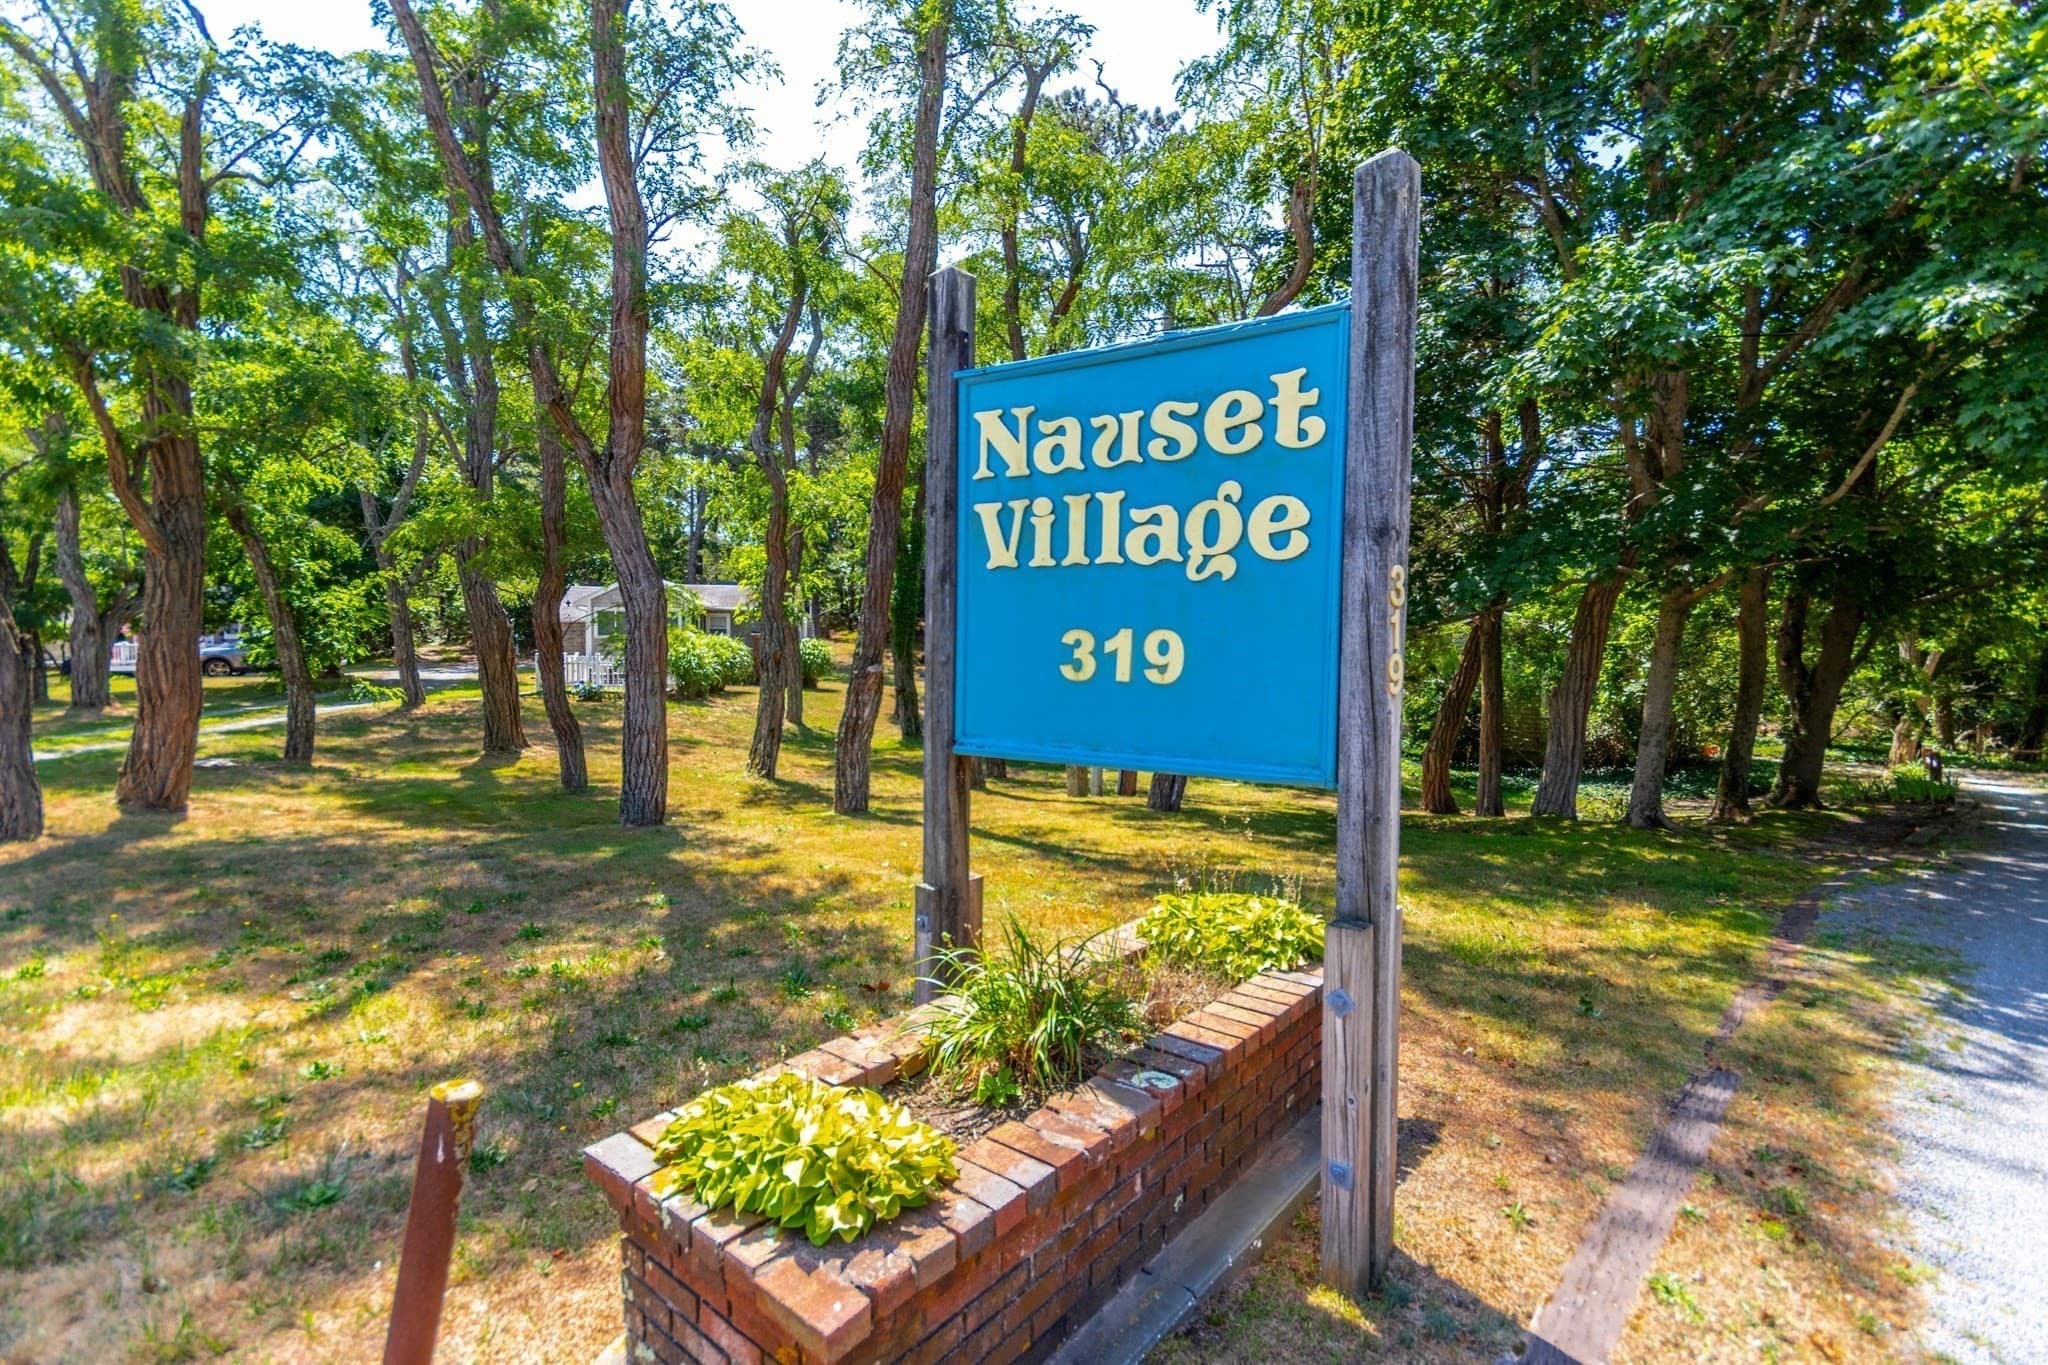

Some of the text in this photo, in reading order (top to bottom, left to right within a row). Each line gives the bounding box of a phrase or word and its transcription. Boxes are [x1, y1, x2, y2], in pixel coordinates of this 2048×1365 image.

[973, 367, 1326, 480] Nauset
[973, 480, 1311, 582] Village
[1059, 628, 1185, 684] 319
[1388, 564, 1405, 696] 319
